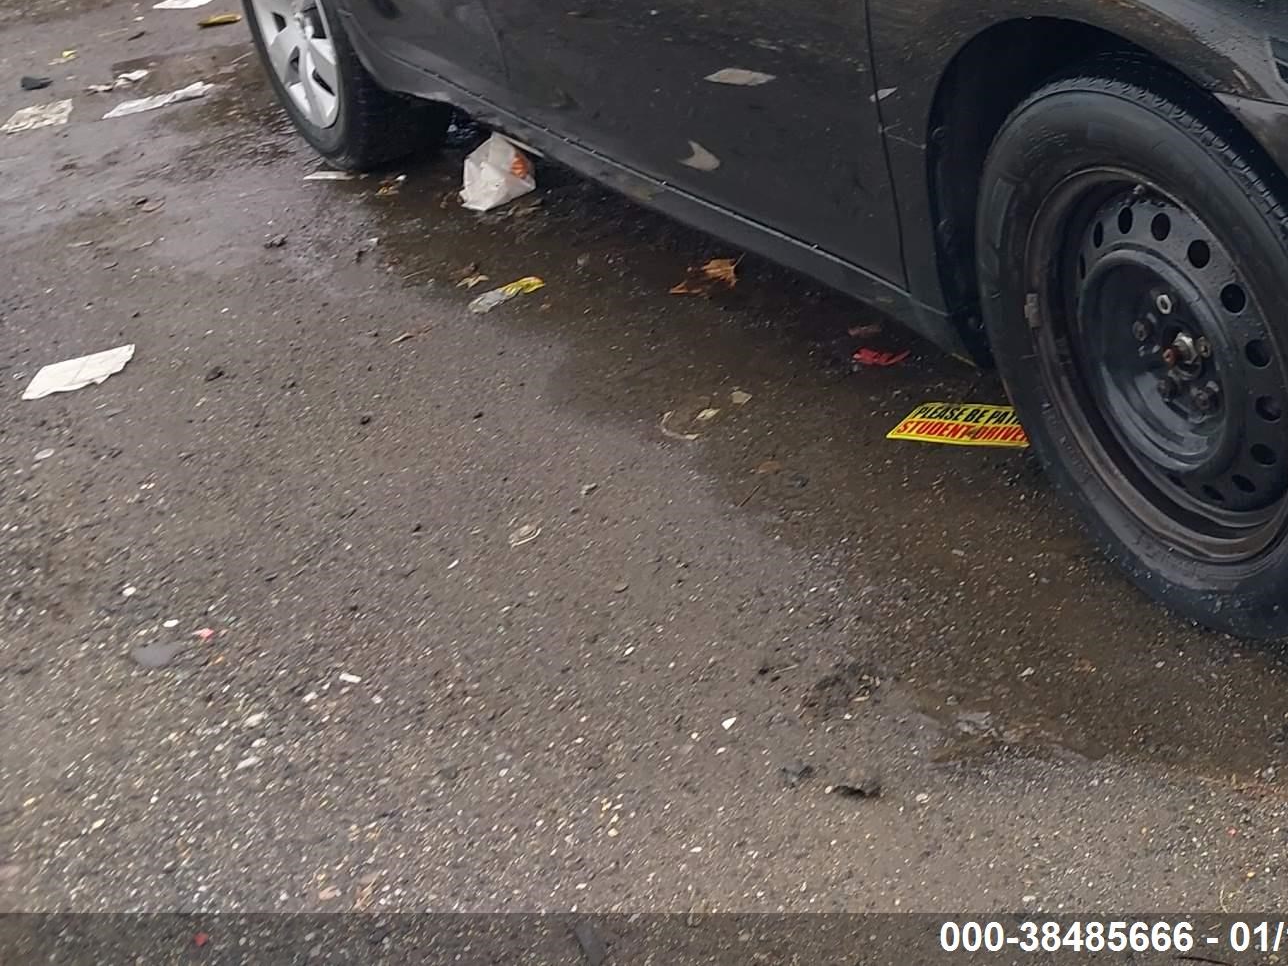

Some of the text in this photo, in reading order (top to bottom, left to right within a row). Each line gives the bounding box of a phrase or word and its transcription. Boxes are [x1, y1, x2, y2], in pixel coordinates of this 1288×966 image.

[913, 406, 966, 421] PLEASE
[963, 409, 987, 424] BE
[897, 421, 972, 439] STUDENT
